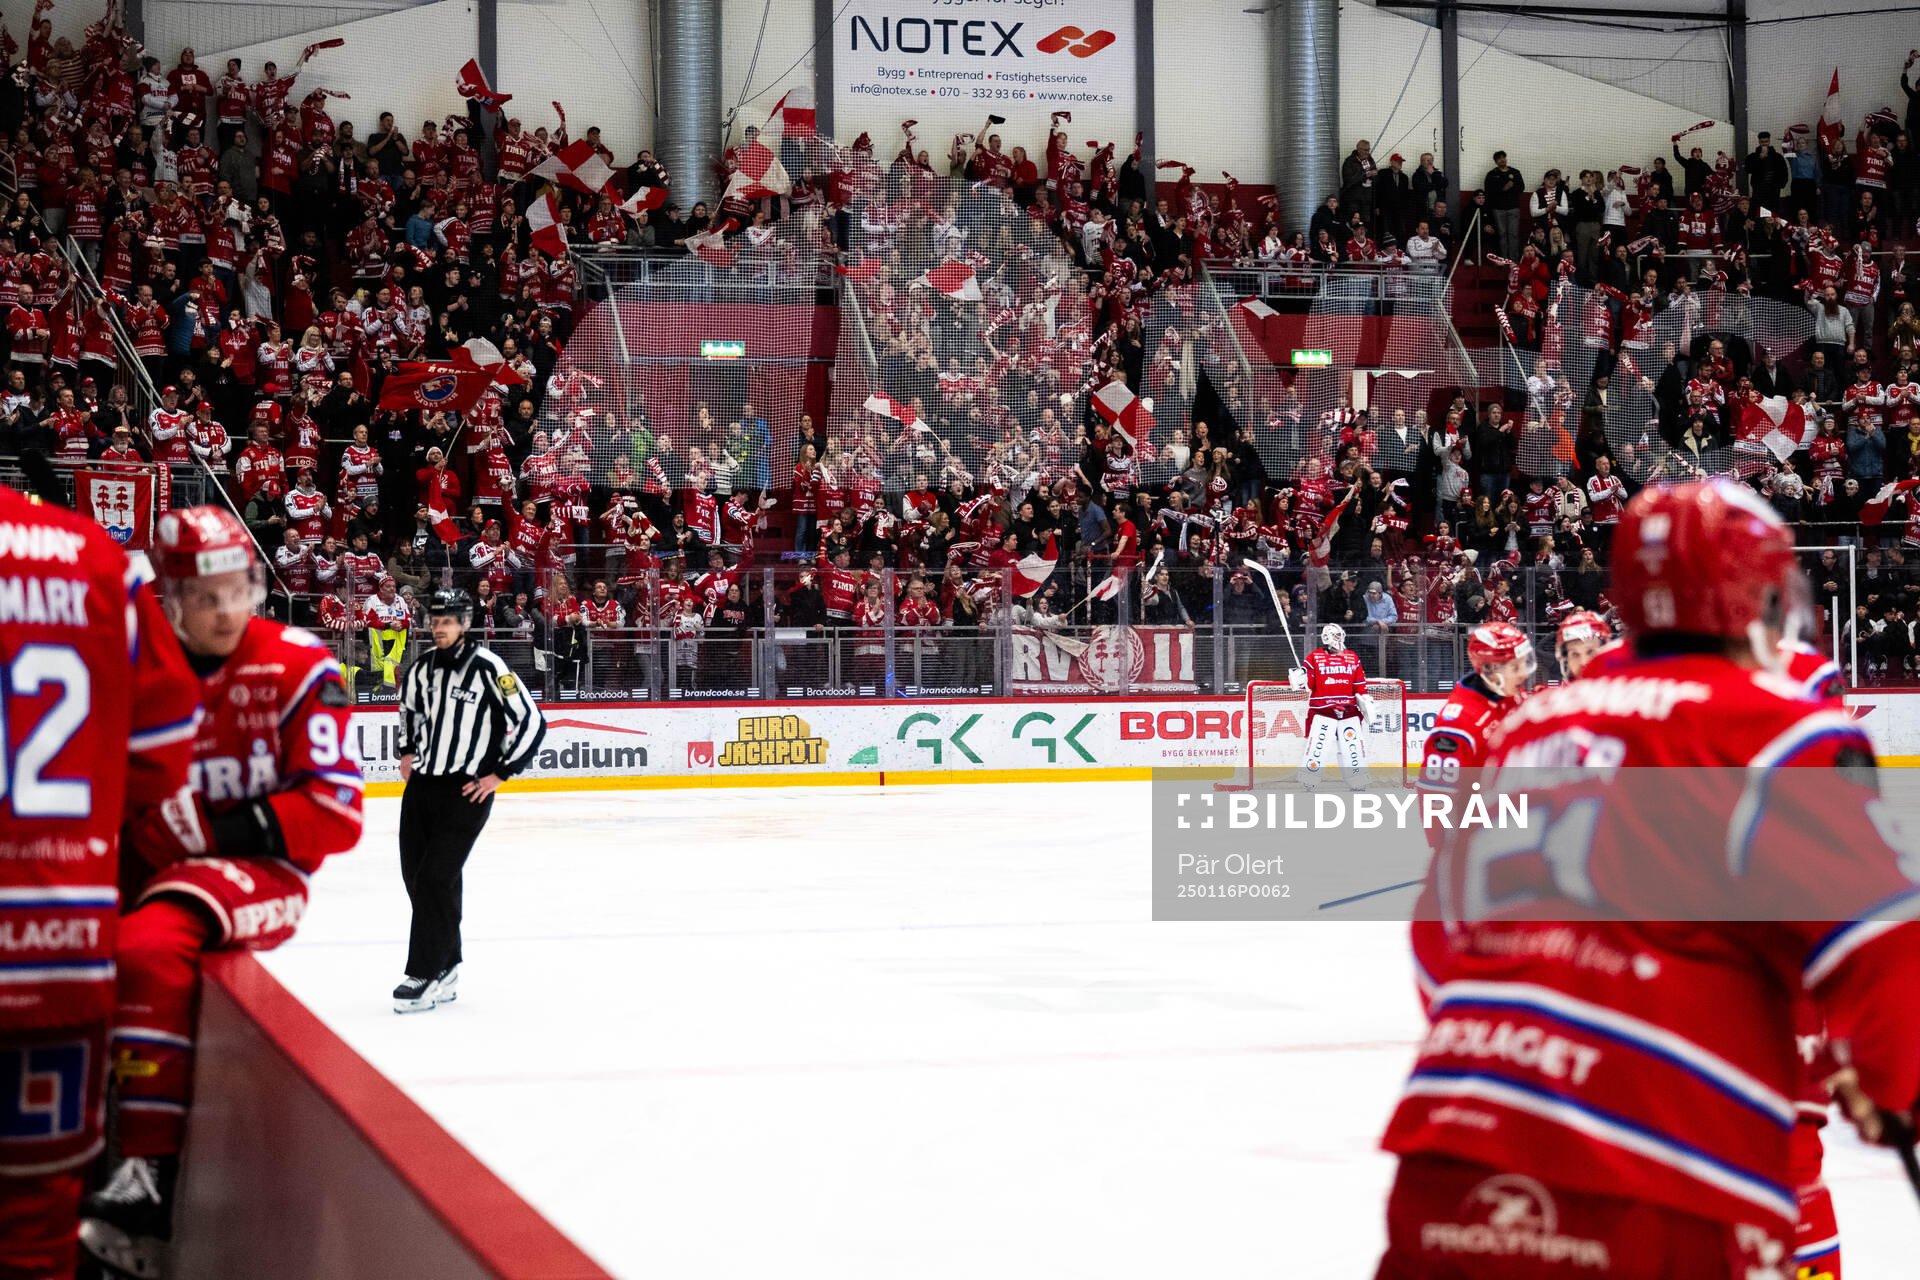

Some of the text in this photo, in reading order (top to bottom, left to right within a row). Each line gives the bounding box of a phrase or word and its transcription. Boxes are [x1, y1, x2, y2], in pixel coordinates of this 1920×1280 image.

[850, 15, 1024, 58] NOTEX
[877, 66, 1088, 84] Bygg Entreprenad Fastighetsservice
[850, 83, 927, 96] info@notex.se
[939, 87, 960, 97] 070
[972, 88, 992, 98] 332
[995, 89, 1009, 99] 93
[1012, 90, 1026, 99] 66
[1038, 91, 1113, 102] www.notex.se
[1319, 664, 1353, 675] TIMRÅ
[451, 688, 475, 702] SHL
[684, 688, 746, 697] brandcode.se
[920, 686, 979, 694] brandcode.se
[0, 643, 92, 818] 2
[737, 715, 800, 742] EURO
[896, 712, 985, 765] GK
[1011, 711, 1098, 763] GK
[1119, 709, 1304, 740] BORGA
[718, 738, 823, 766] JACKPOT
[1162, 749, 1184, 757] BYGG
[1313, 724, 1329, 758] COOR
[1348, 743, 1360, 774] COOR
[1425, 754, 1461, 783] 89
[0, 917, 101, 951] LAGET
